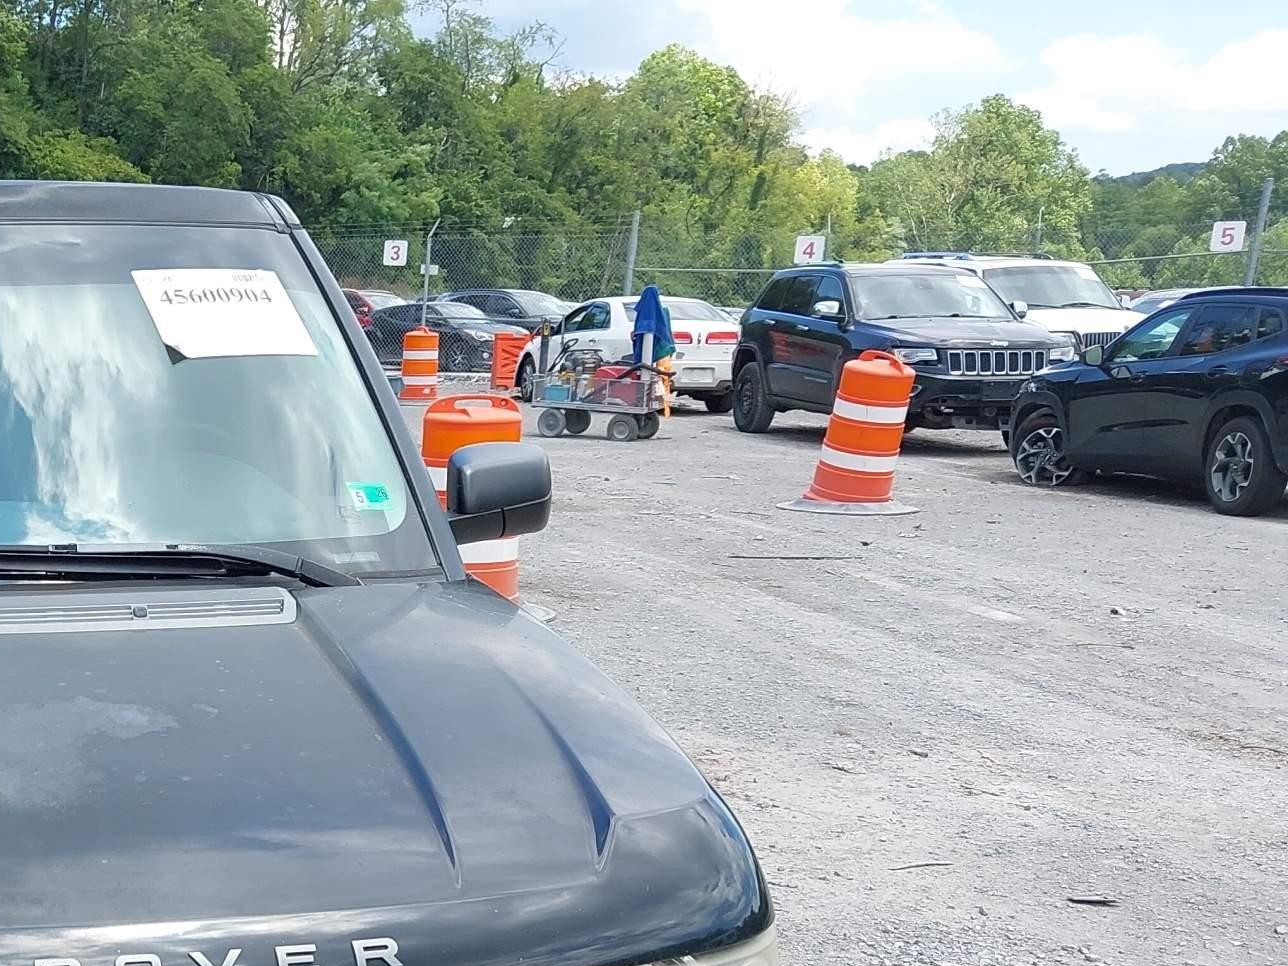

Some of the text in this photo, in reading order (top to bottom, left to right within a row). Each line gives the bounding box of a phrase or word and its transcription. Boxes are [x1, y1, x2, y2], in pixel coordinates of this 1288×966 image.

[1220, 226, 1236, 246] 5
[390, 245, 400, 261] 3
[802, 241, 816, 259] 4
[159, 287, 272, 305] 45600904
